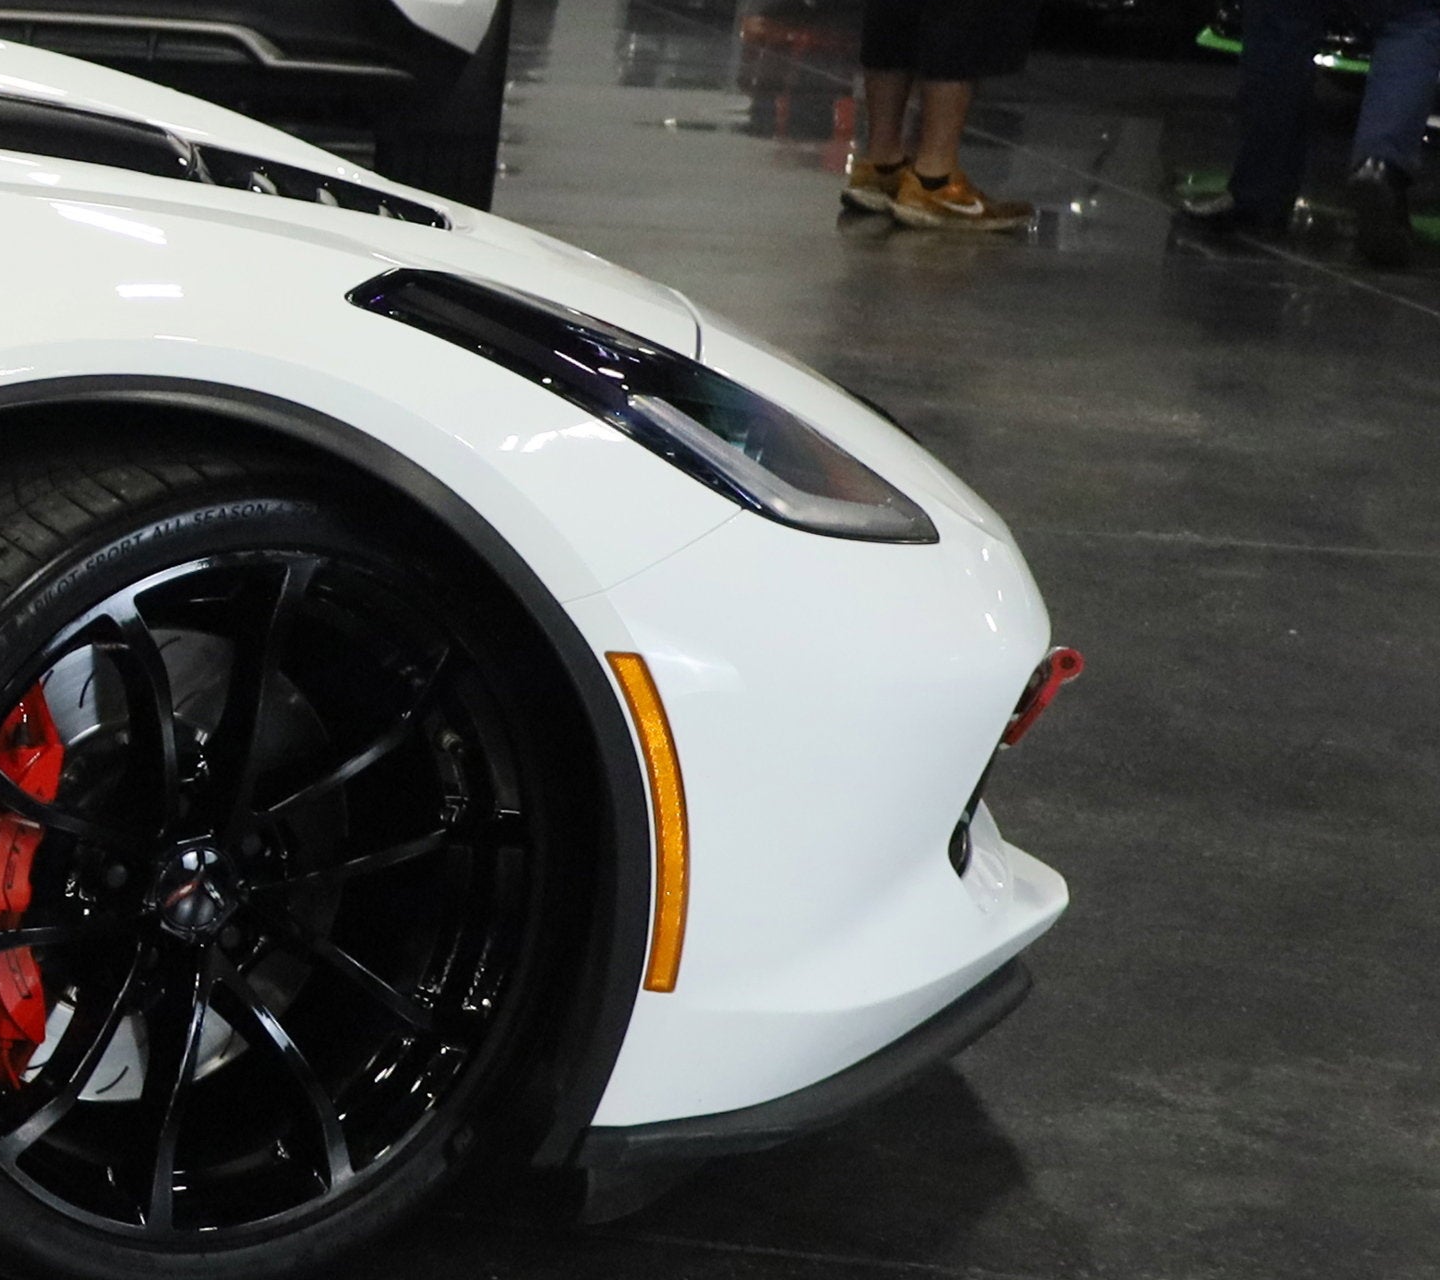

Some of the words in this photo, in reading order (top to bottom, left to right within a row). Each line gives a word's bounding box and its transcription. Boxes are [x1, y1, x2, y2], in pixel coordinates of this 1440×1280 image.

[33, 570, 79, 614] PILOT
[86, 534, 144, 572] SPORT
[152, 517, 186, 539] ALL
[193, 503, 269, 525] SEASON
